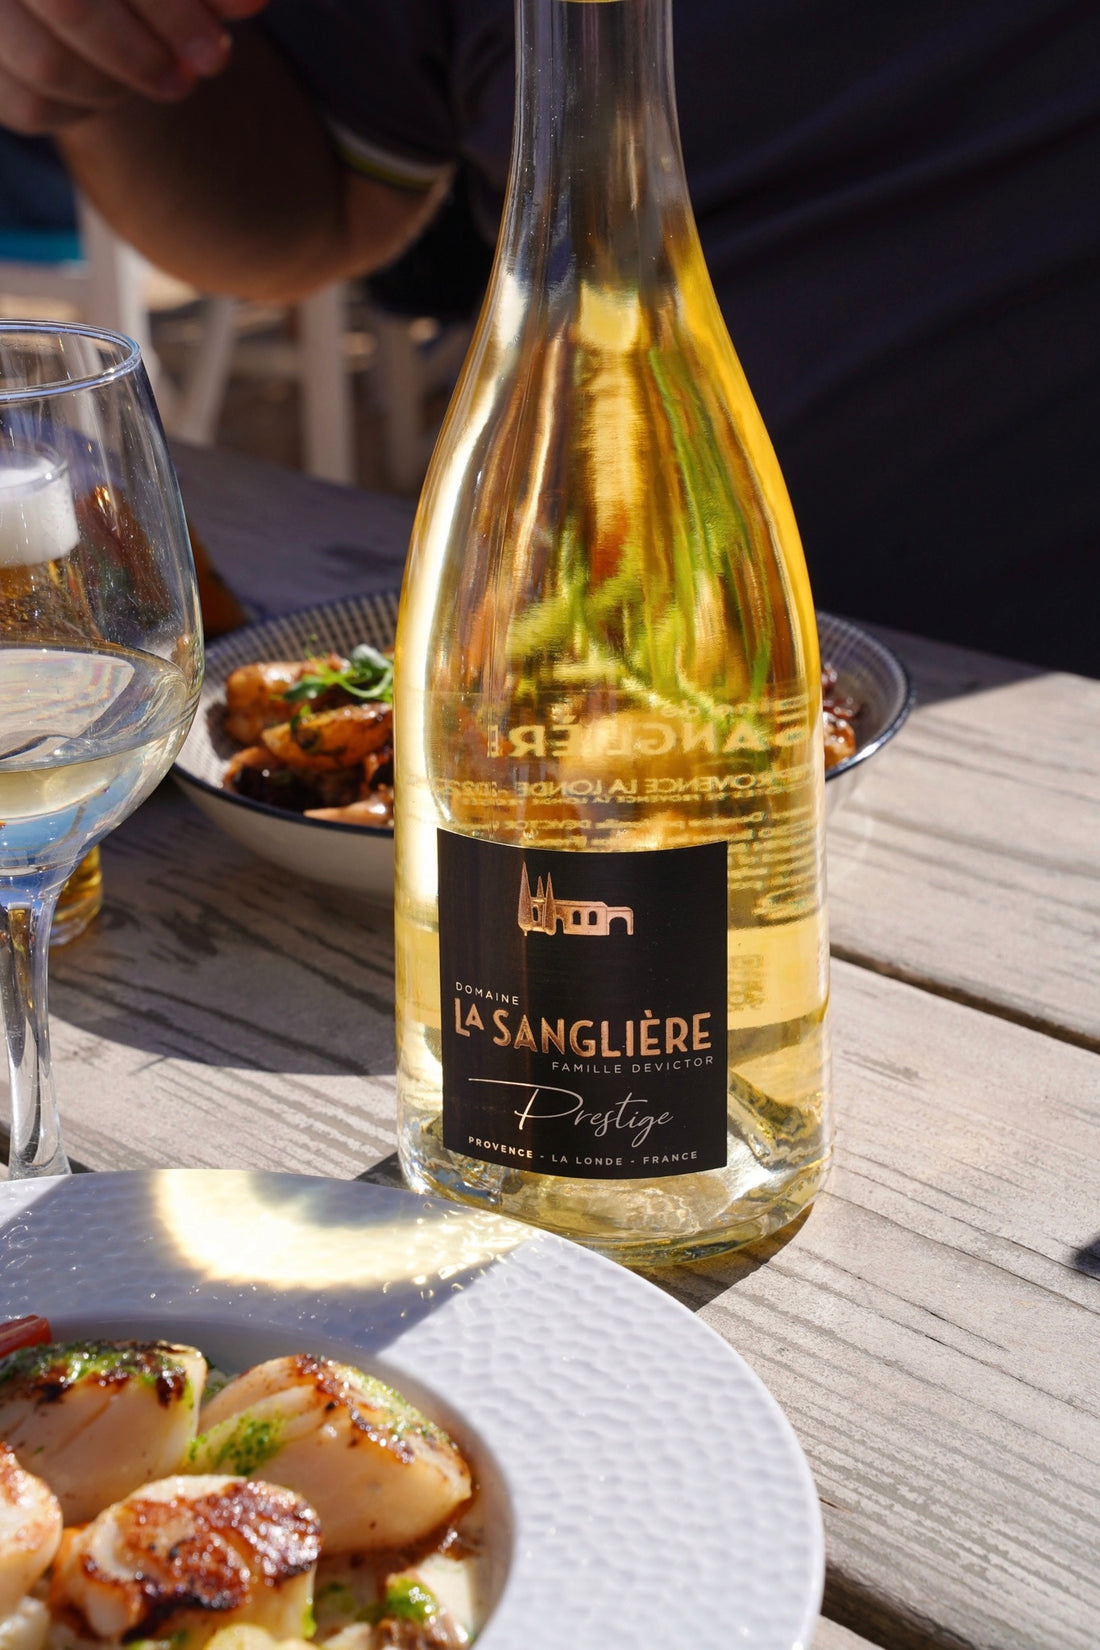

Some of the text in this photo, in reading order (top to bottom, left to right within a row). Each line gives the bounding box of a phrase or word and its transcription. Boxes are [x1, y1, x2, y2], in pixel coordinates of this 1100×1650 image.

[455, 981, 519, 1006] DOMAINE
[454, 997, 712, 1058] LA SANGLIÈRE
[551, 1055, 714, 1074] FAMILLE DEVICTOR
[467, 1077, 674, 1148] Prestige
[468, 1135, 534, 1159] PROVENCE
[551, 1154, 569, 1164] LA
[575, 1155, 623, 1166] LONDE
[642, 1150, 698, 1164] FRANCE
